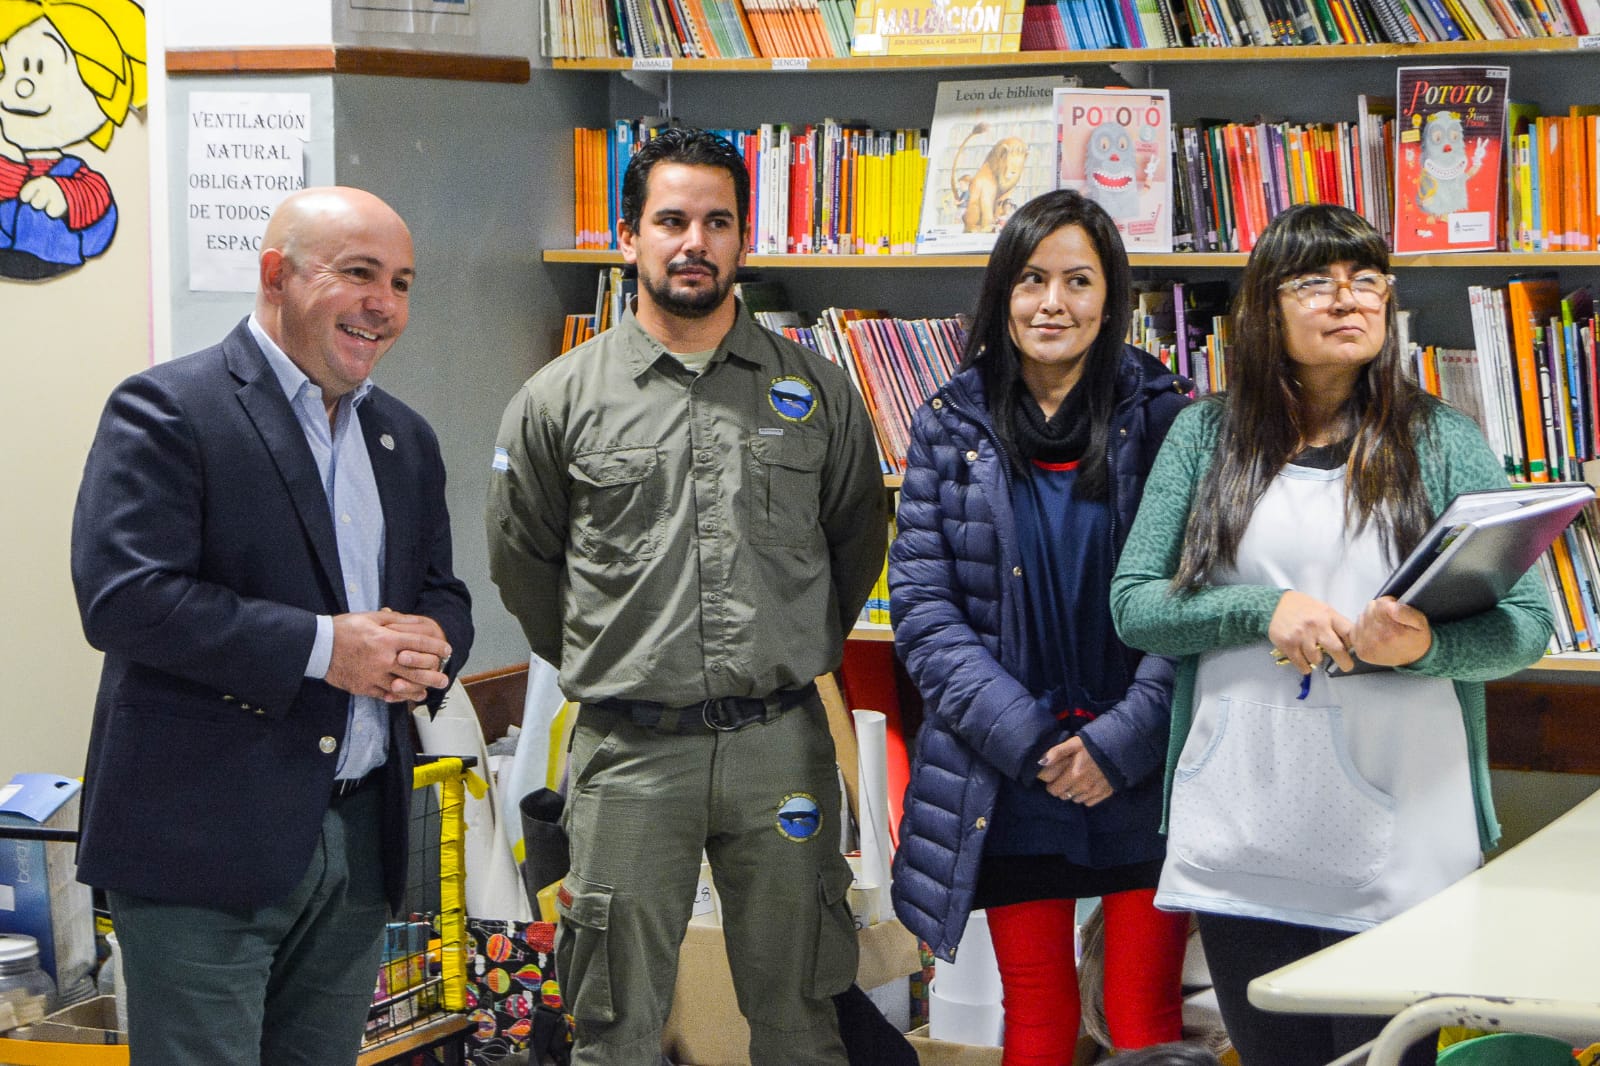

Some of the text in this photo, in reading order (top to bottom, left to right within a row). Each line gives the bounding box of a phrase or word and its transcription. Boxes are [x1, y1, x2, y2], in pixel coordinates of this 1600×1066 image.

[634, 59, 671, 68] ANIMALES
[773, 59, 806, 67] CIENCIAS
[956, 89, 985, 101] León
[989, 87, 1002, 99] de
[1403, 80, 1493, 116] POTOTO
[192, 110, 305, 130] VENTILACIÓN
[1072, 106, 1161, 127] POTOTO
[206, 143, 291, 161] NATURAL
[189, 174, 305, 191] OBLIGATORIA
[189, 204, 271, 221] DE TODOS
[207, 234, 263, 251] ESPAC
